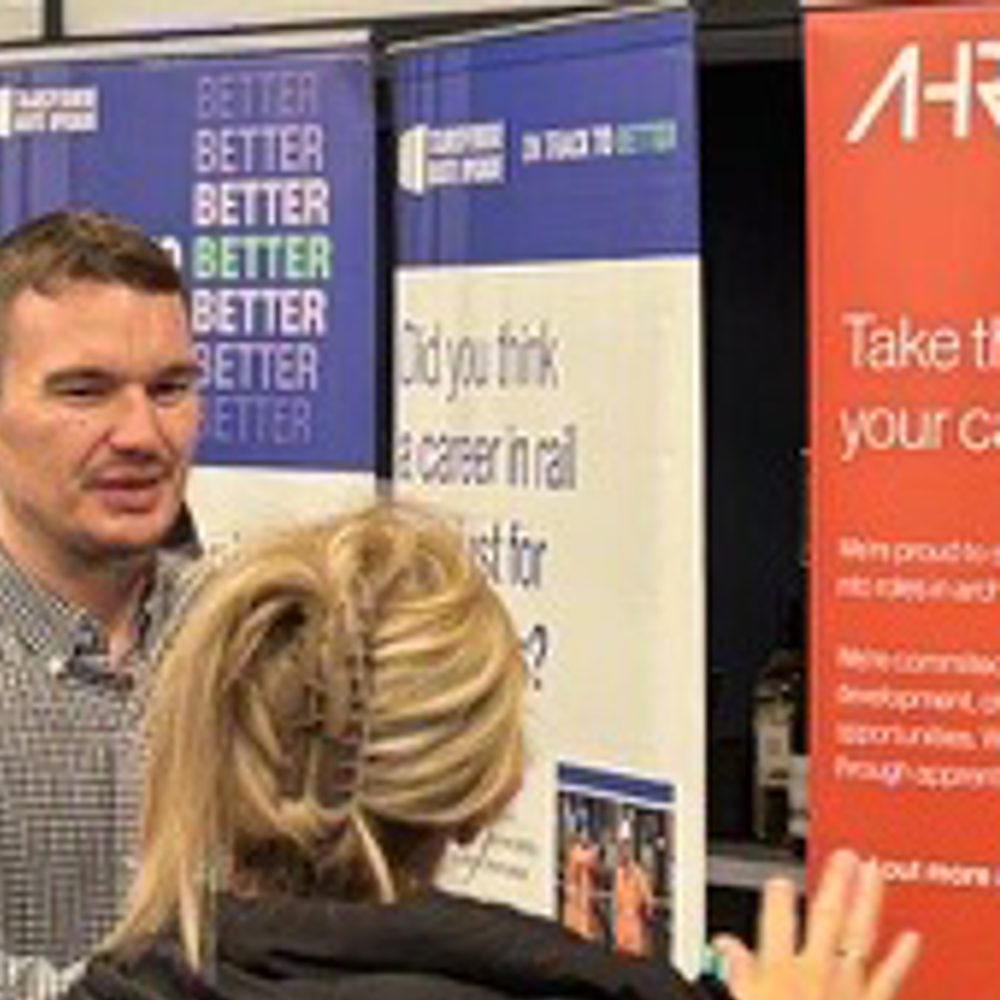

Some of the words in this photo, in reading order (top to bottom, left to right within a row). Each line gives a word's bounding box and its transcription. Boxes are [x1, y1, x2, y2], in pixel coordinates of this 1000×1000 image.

[198, 72, 318, 120] BETTER
[195, 124, 324, 173] BETTER
[193, 178, 330, 227] BETTER
[193, 236, 332, 280] BETTER
[192, 289, 328, 337] BETTER
[497, 319, 560, 390] think
[842, 312, 960, 370] Take
[203, 399, 312, 444] ETTER
[840, 404, 950, 462] your
[415, 434, 501, 486] career
[506, 424, 530, 486] in
[534, 422, 577, 492] rail
[508, 520, 547, 588] for
[927, 861, 990, 887] more
